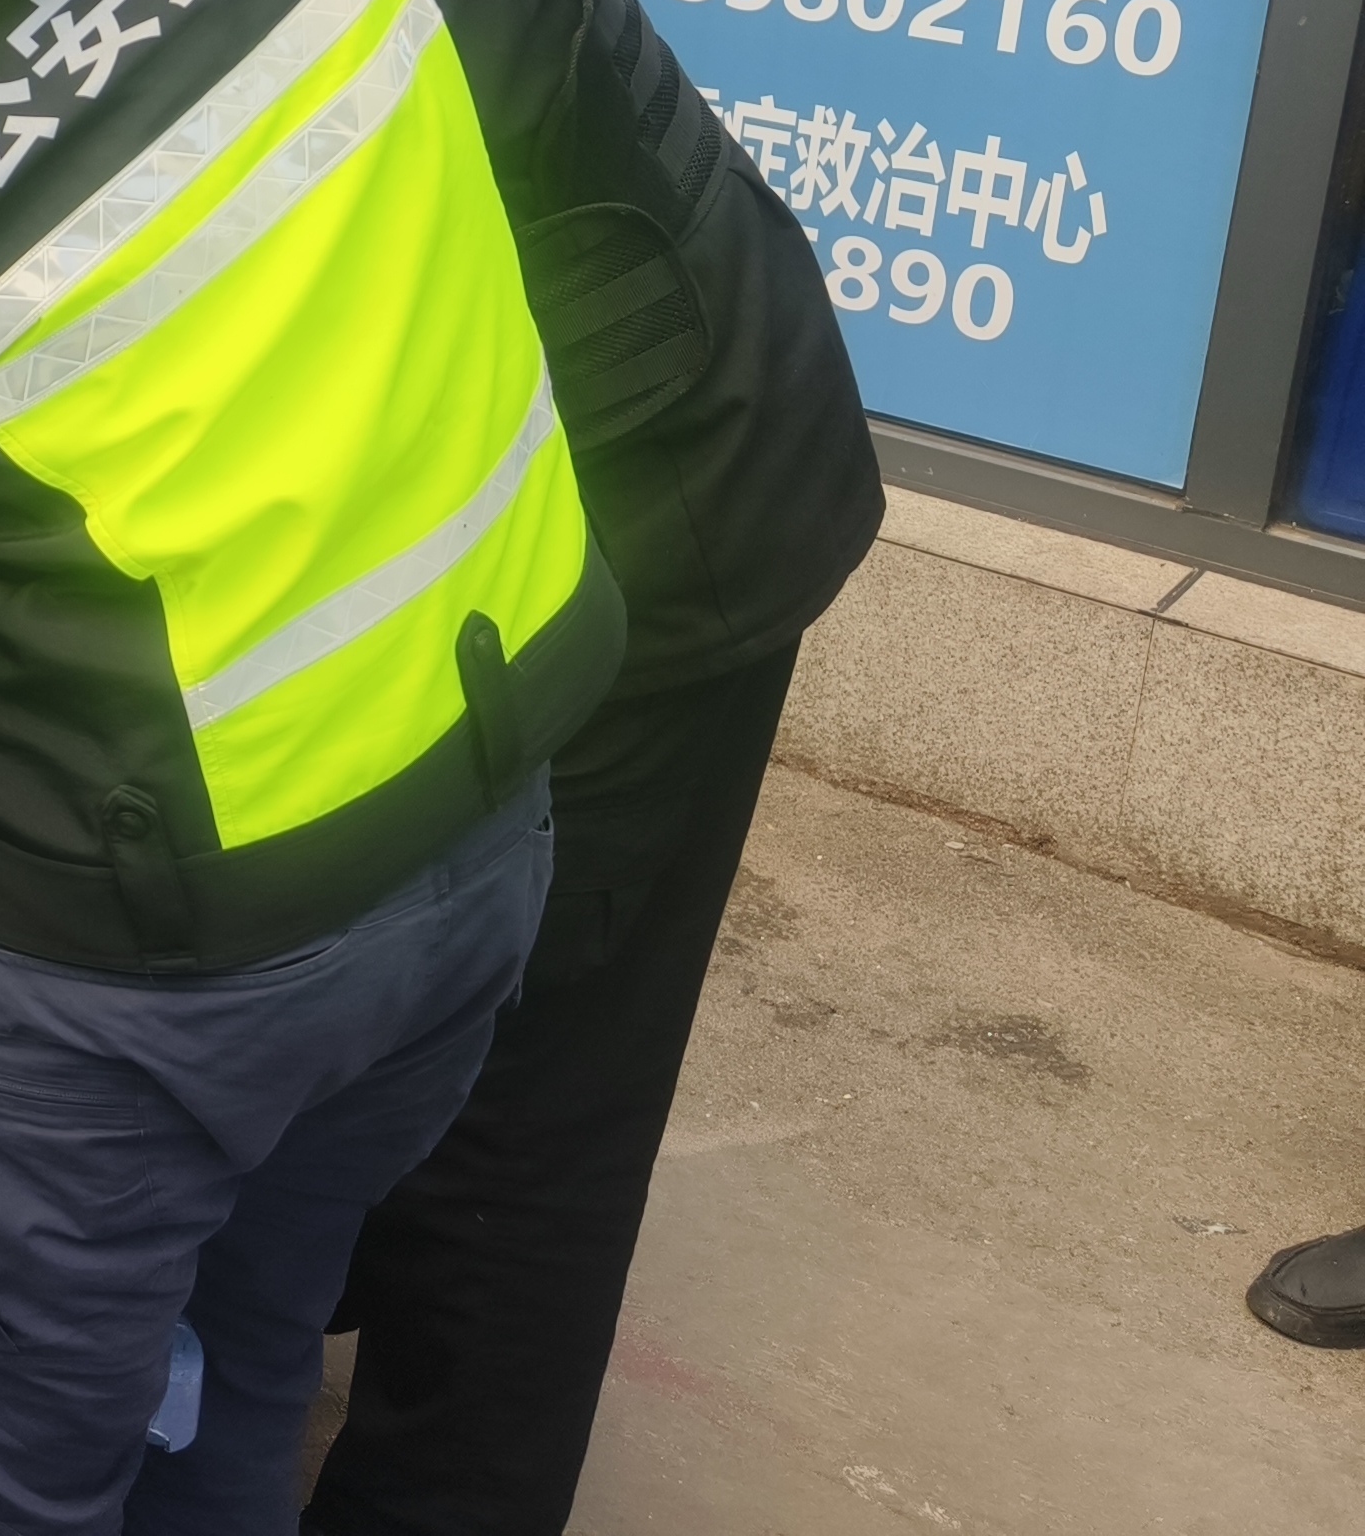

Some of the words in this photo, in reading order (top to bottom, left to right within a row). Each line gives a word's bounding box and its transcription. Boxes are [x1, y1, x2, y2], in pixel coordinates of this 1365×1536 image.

[695, 85, 1107, 264] 症救治中心
[804, 224, 1014, 341] 890
